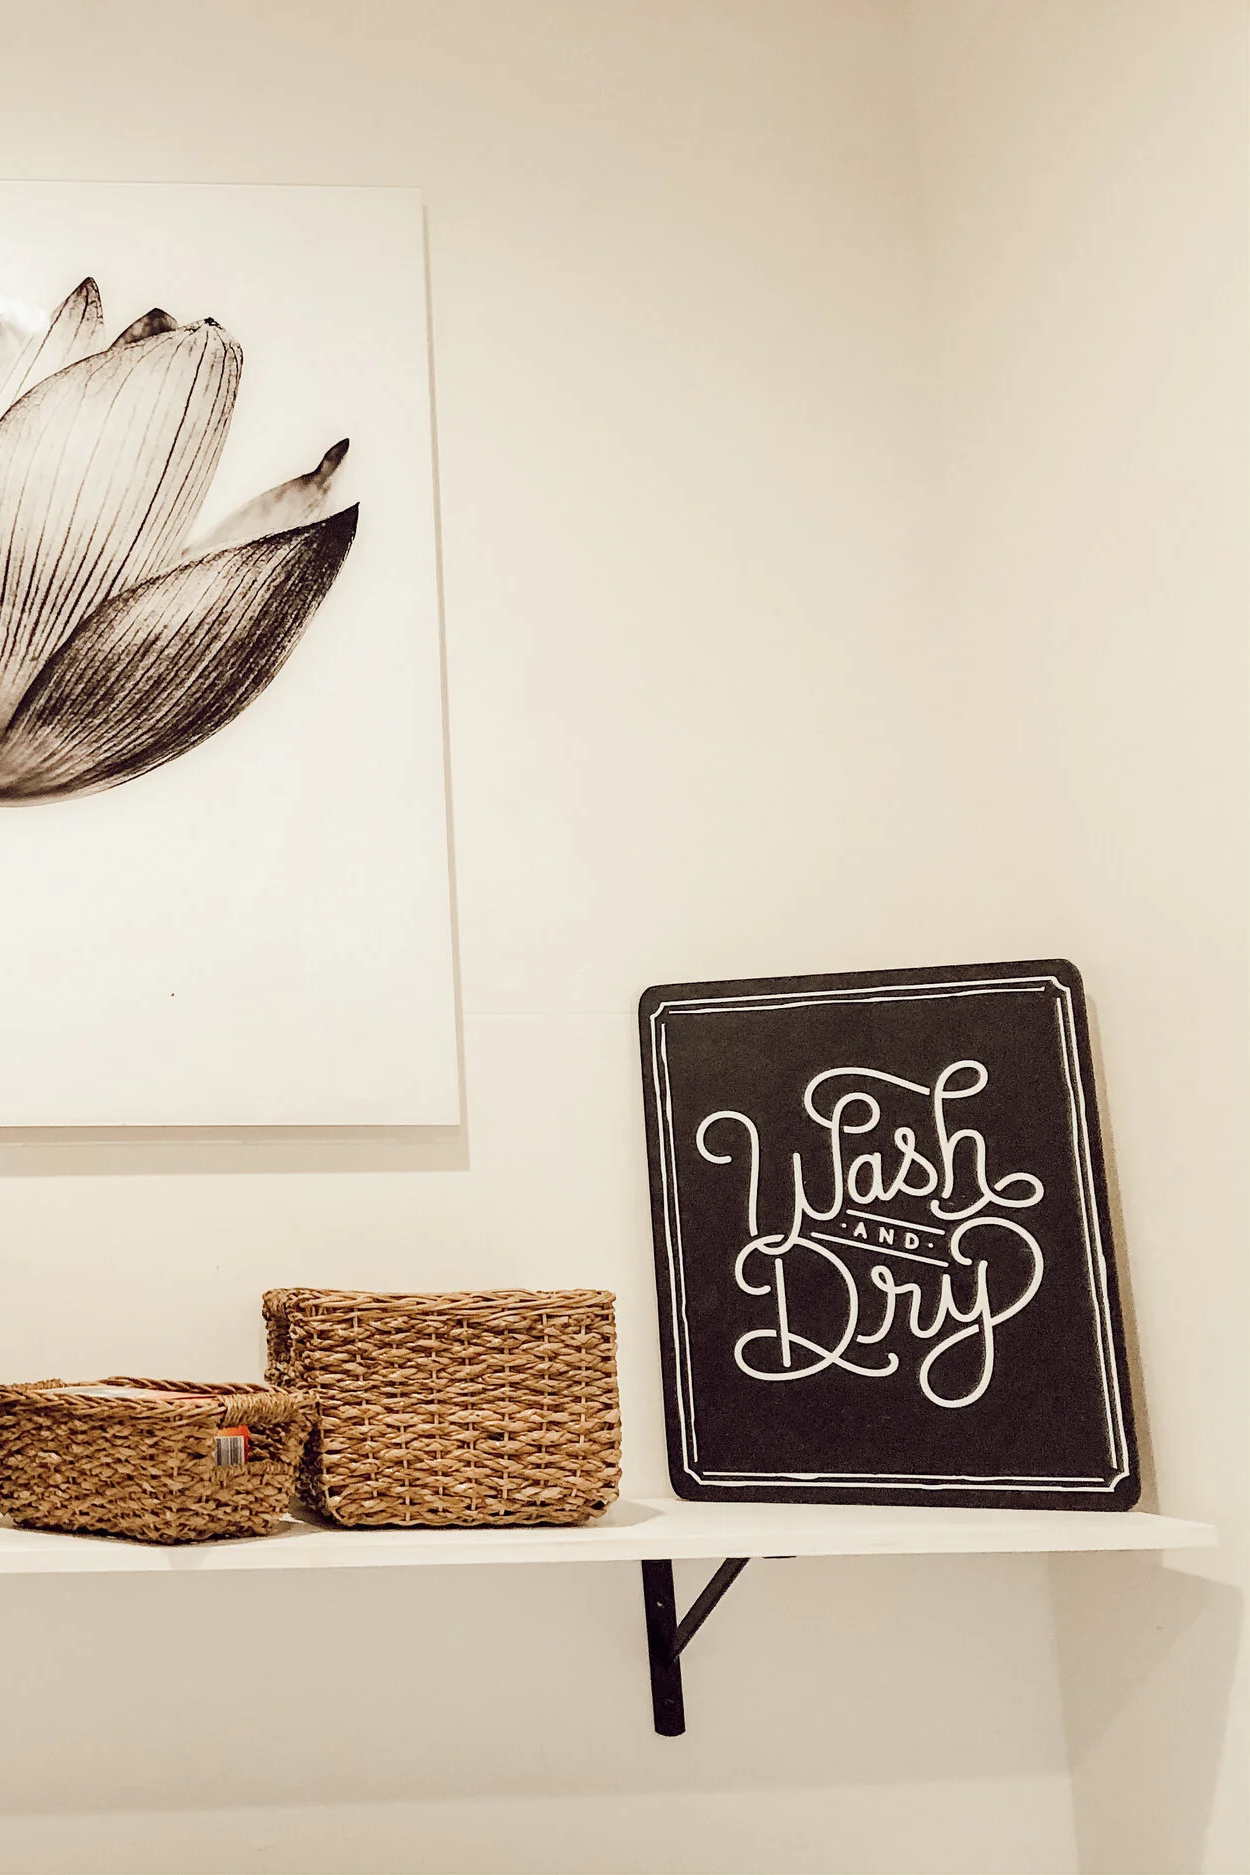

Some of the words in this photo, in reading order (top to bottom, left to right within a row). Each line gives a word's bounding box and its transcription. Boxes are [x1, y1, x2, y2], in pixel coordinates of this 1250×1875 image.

[696, 1060, 1045, 1256] Wash
[853, 1221, 920, 1250] AND
[734, 1216, 1045, 1409] Dry
